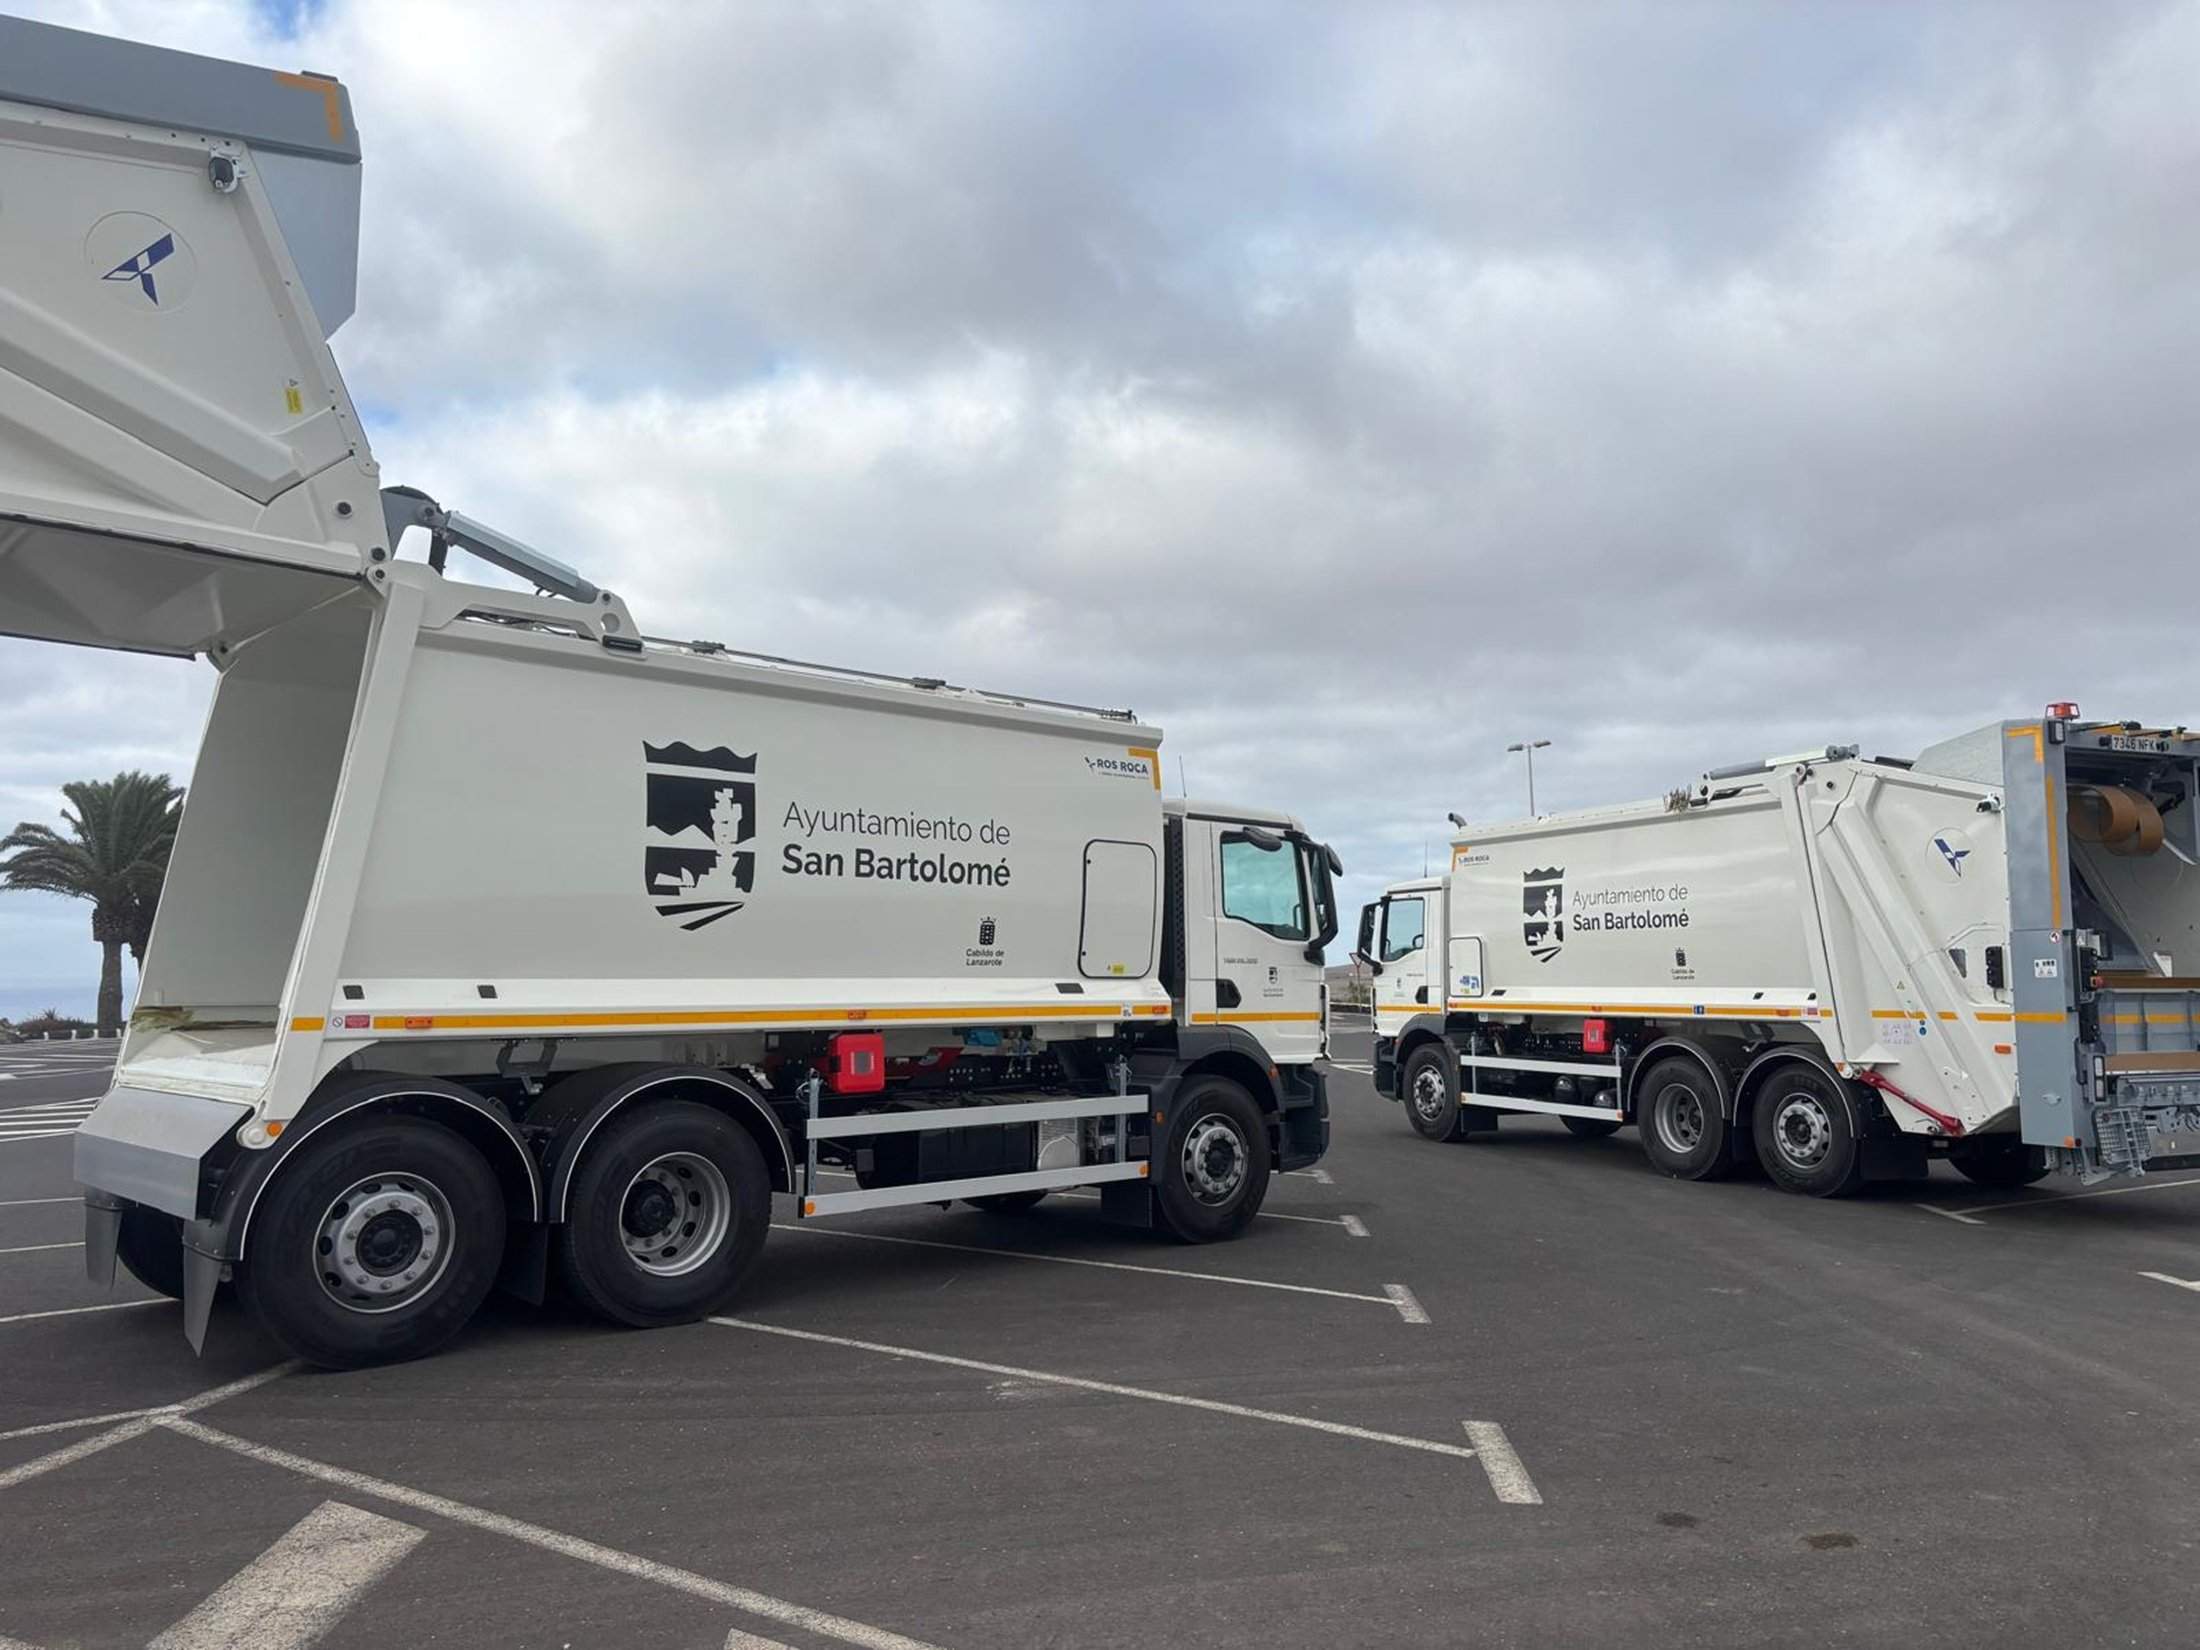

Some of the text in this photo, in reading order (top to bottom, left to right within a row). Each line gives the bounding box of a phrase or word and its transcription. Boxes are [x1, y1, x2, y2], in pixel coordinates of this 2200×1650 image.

[1096, 758, 1149, 775] ROS ROCA
[783, 801, 1011, 845] Ayuntamiento de
[782, 843, 1011, 887] San Bartolomé
[1572, 884, 1689, 910] Ayuntamiento de
[1572, 907, 1690, 932] San Bartolomé
